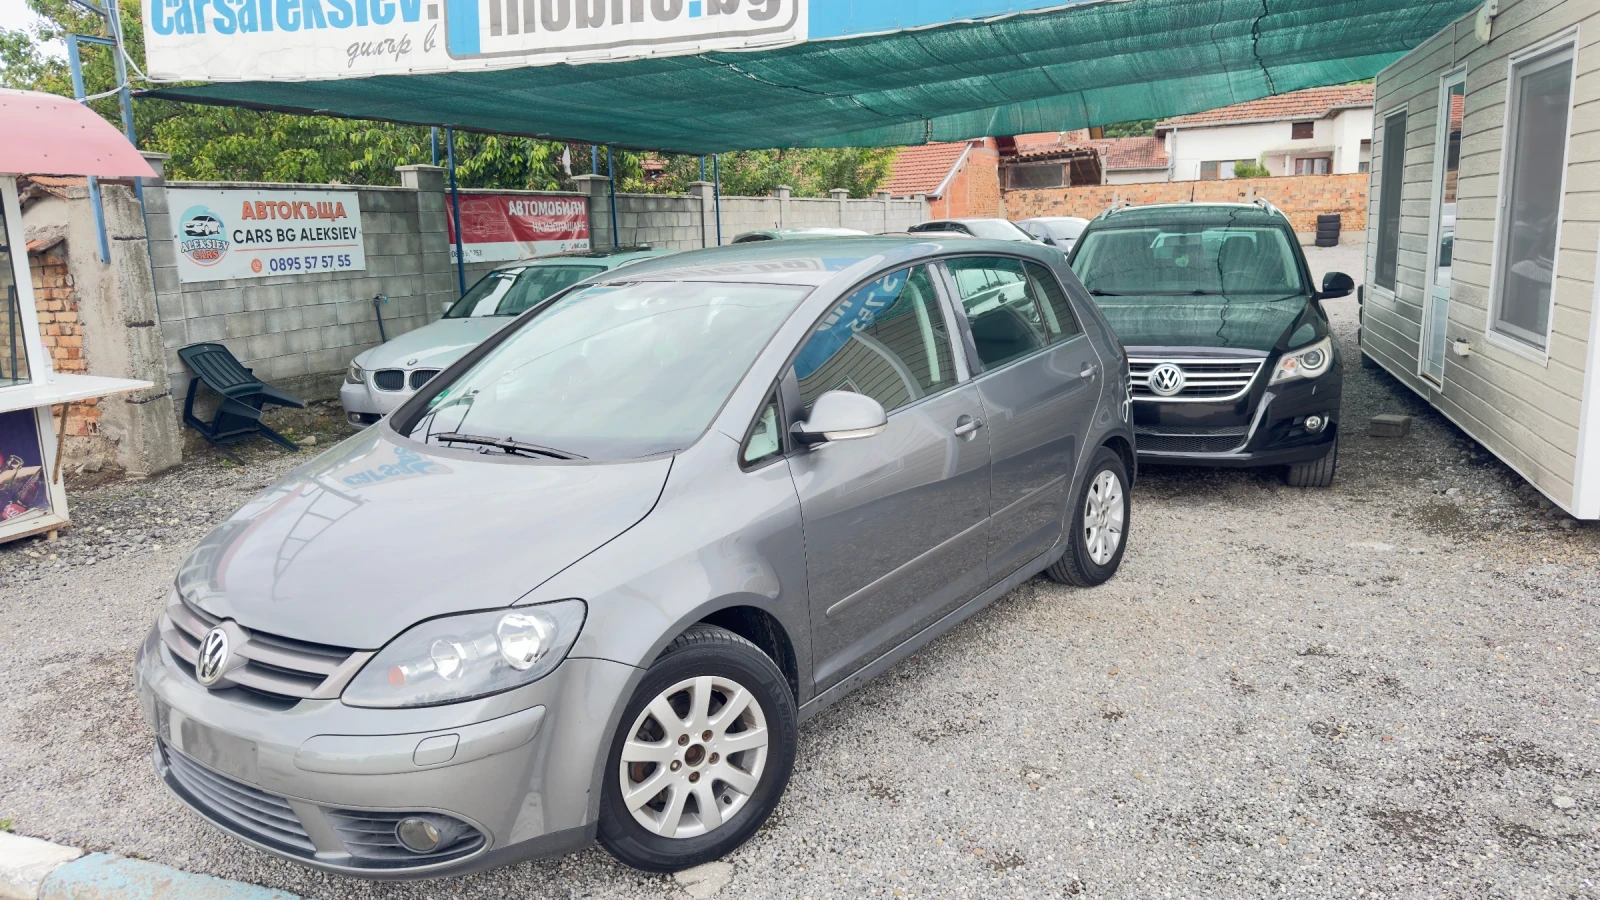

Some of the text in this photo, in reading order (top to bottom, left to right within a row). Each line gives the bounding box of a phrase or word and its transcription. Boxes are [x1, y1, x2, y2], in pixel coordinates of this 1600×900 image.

[242, 201, 347, 221] АВТОКЪЩА
[508, 200, 586, 216] АВТОМОБИЛИ
[232, 226, 357, 244] CARS BG ALEKSIEV
[181, 238, 230, 253] ALEKSIEV
[193, 249, 219, 260] CARS
[269, 254, 351, 272] 0895 57 57 55
[1153, 366, 1182, 392] VW
[199, 629, 228, 683] VW
